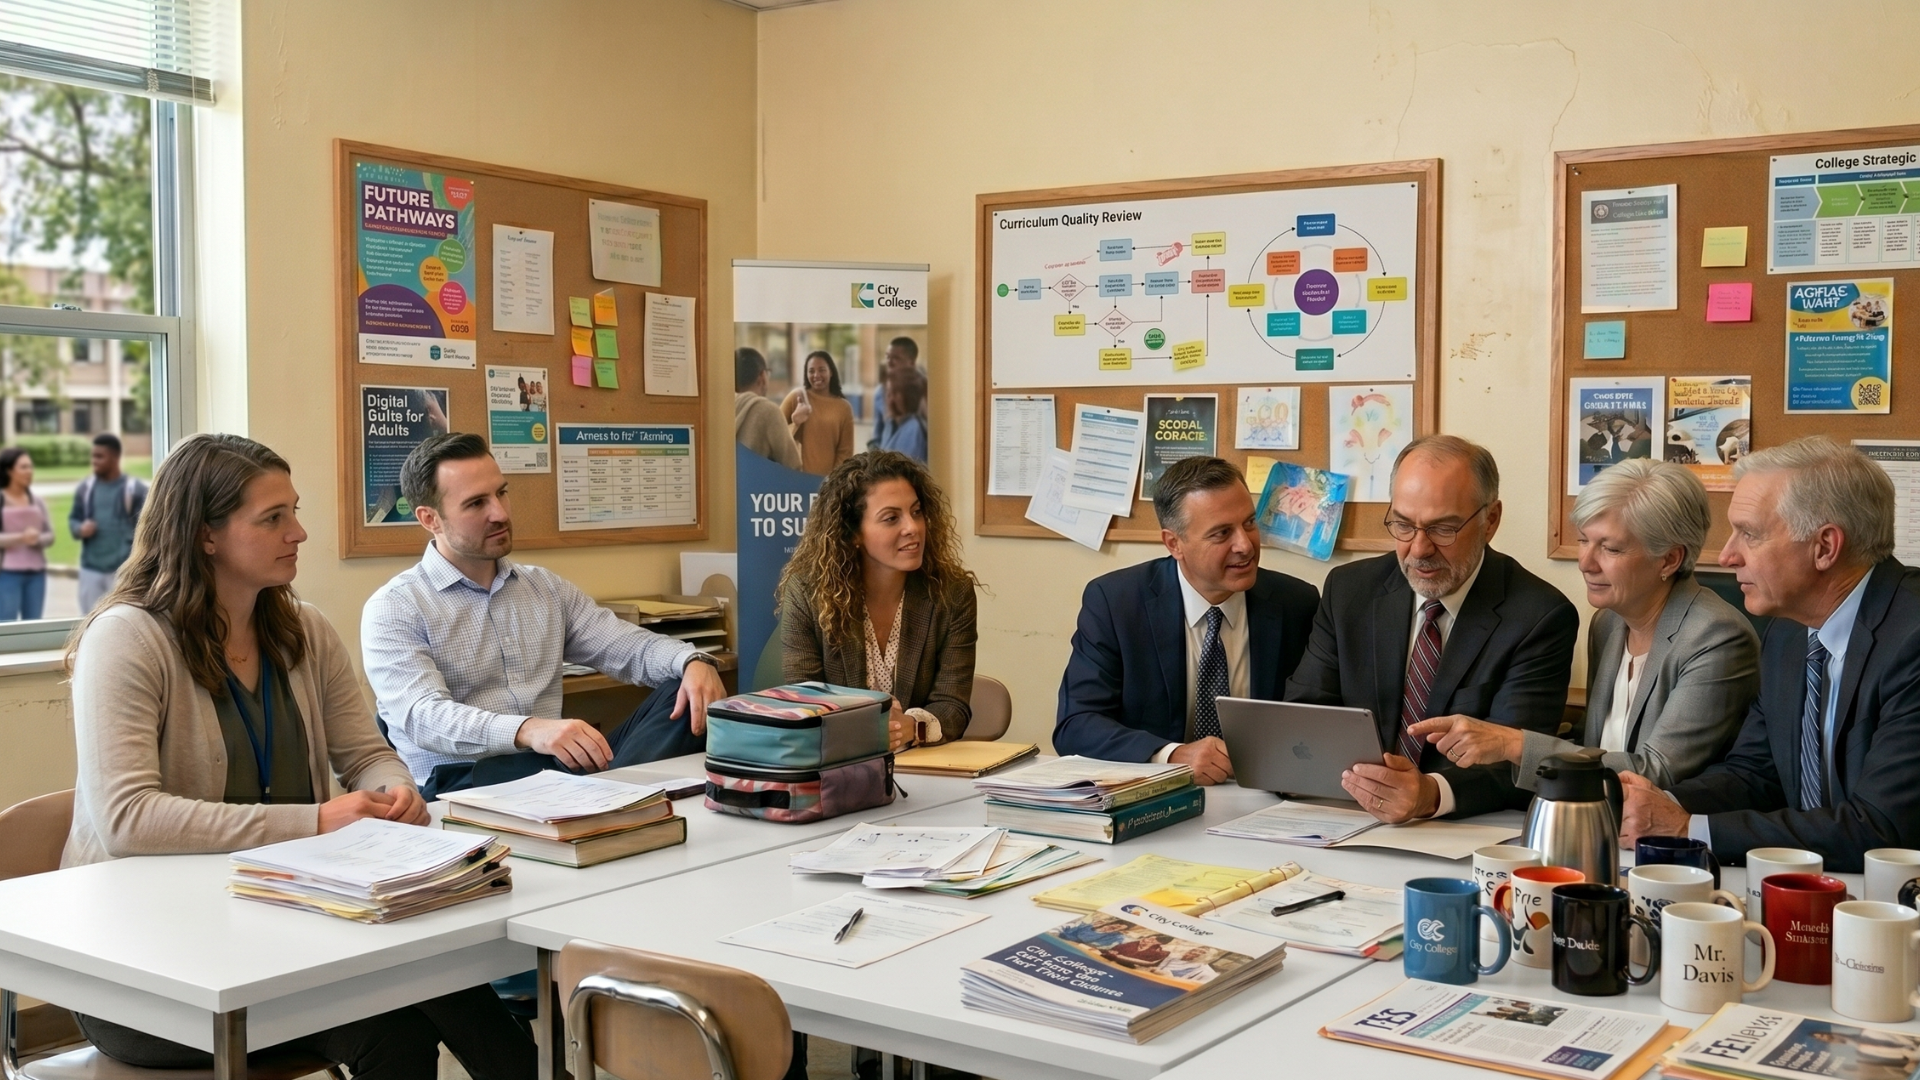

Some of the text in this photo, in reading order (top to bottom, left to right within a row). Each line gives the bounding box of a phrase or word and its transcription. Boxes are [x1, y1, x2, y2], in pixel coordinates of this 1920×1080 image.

[1815, 151, 1917, 169] College Strategic
[364, 184, 430, 208] FUTURE
[364, 203, 455, 230] PATHWAYS
[1000, 210, 1142, 230] Curriculum Quality Review
[877, 284, 899, 296] City
[877, 296, 917, 310] College
[367, 394, 408, 411] Digital
[406, 409, 424, 422] for
[368, 423, 410, 436] Adults
[610, 431, 620, 441] to
[750, 493, 803, 513] YOUR
[750, 517, 776, 537] TO
[1694, 943, 1726, 962] Mr.
[1682, 964, 1734, 983] Davis
